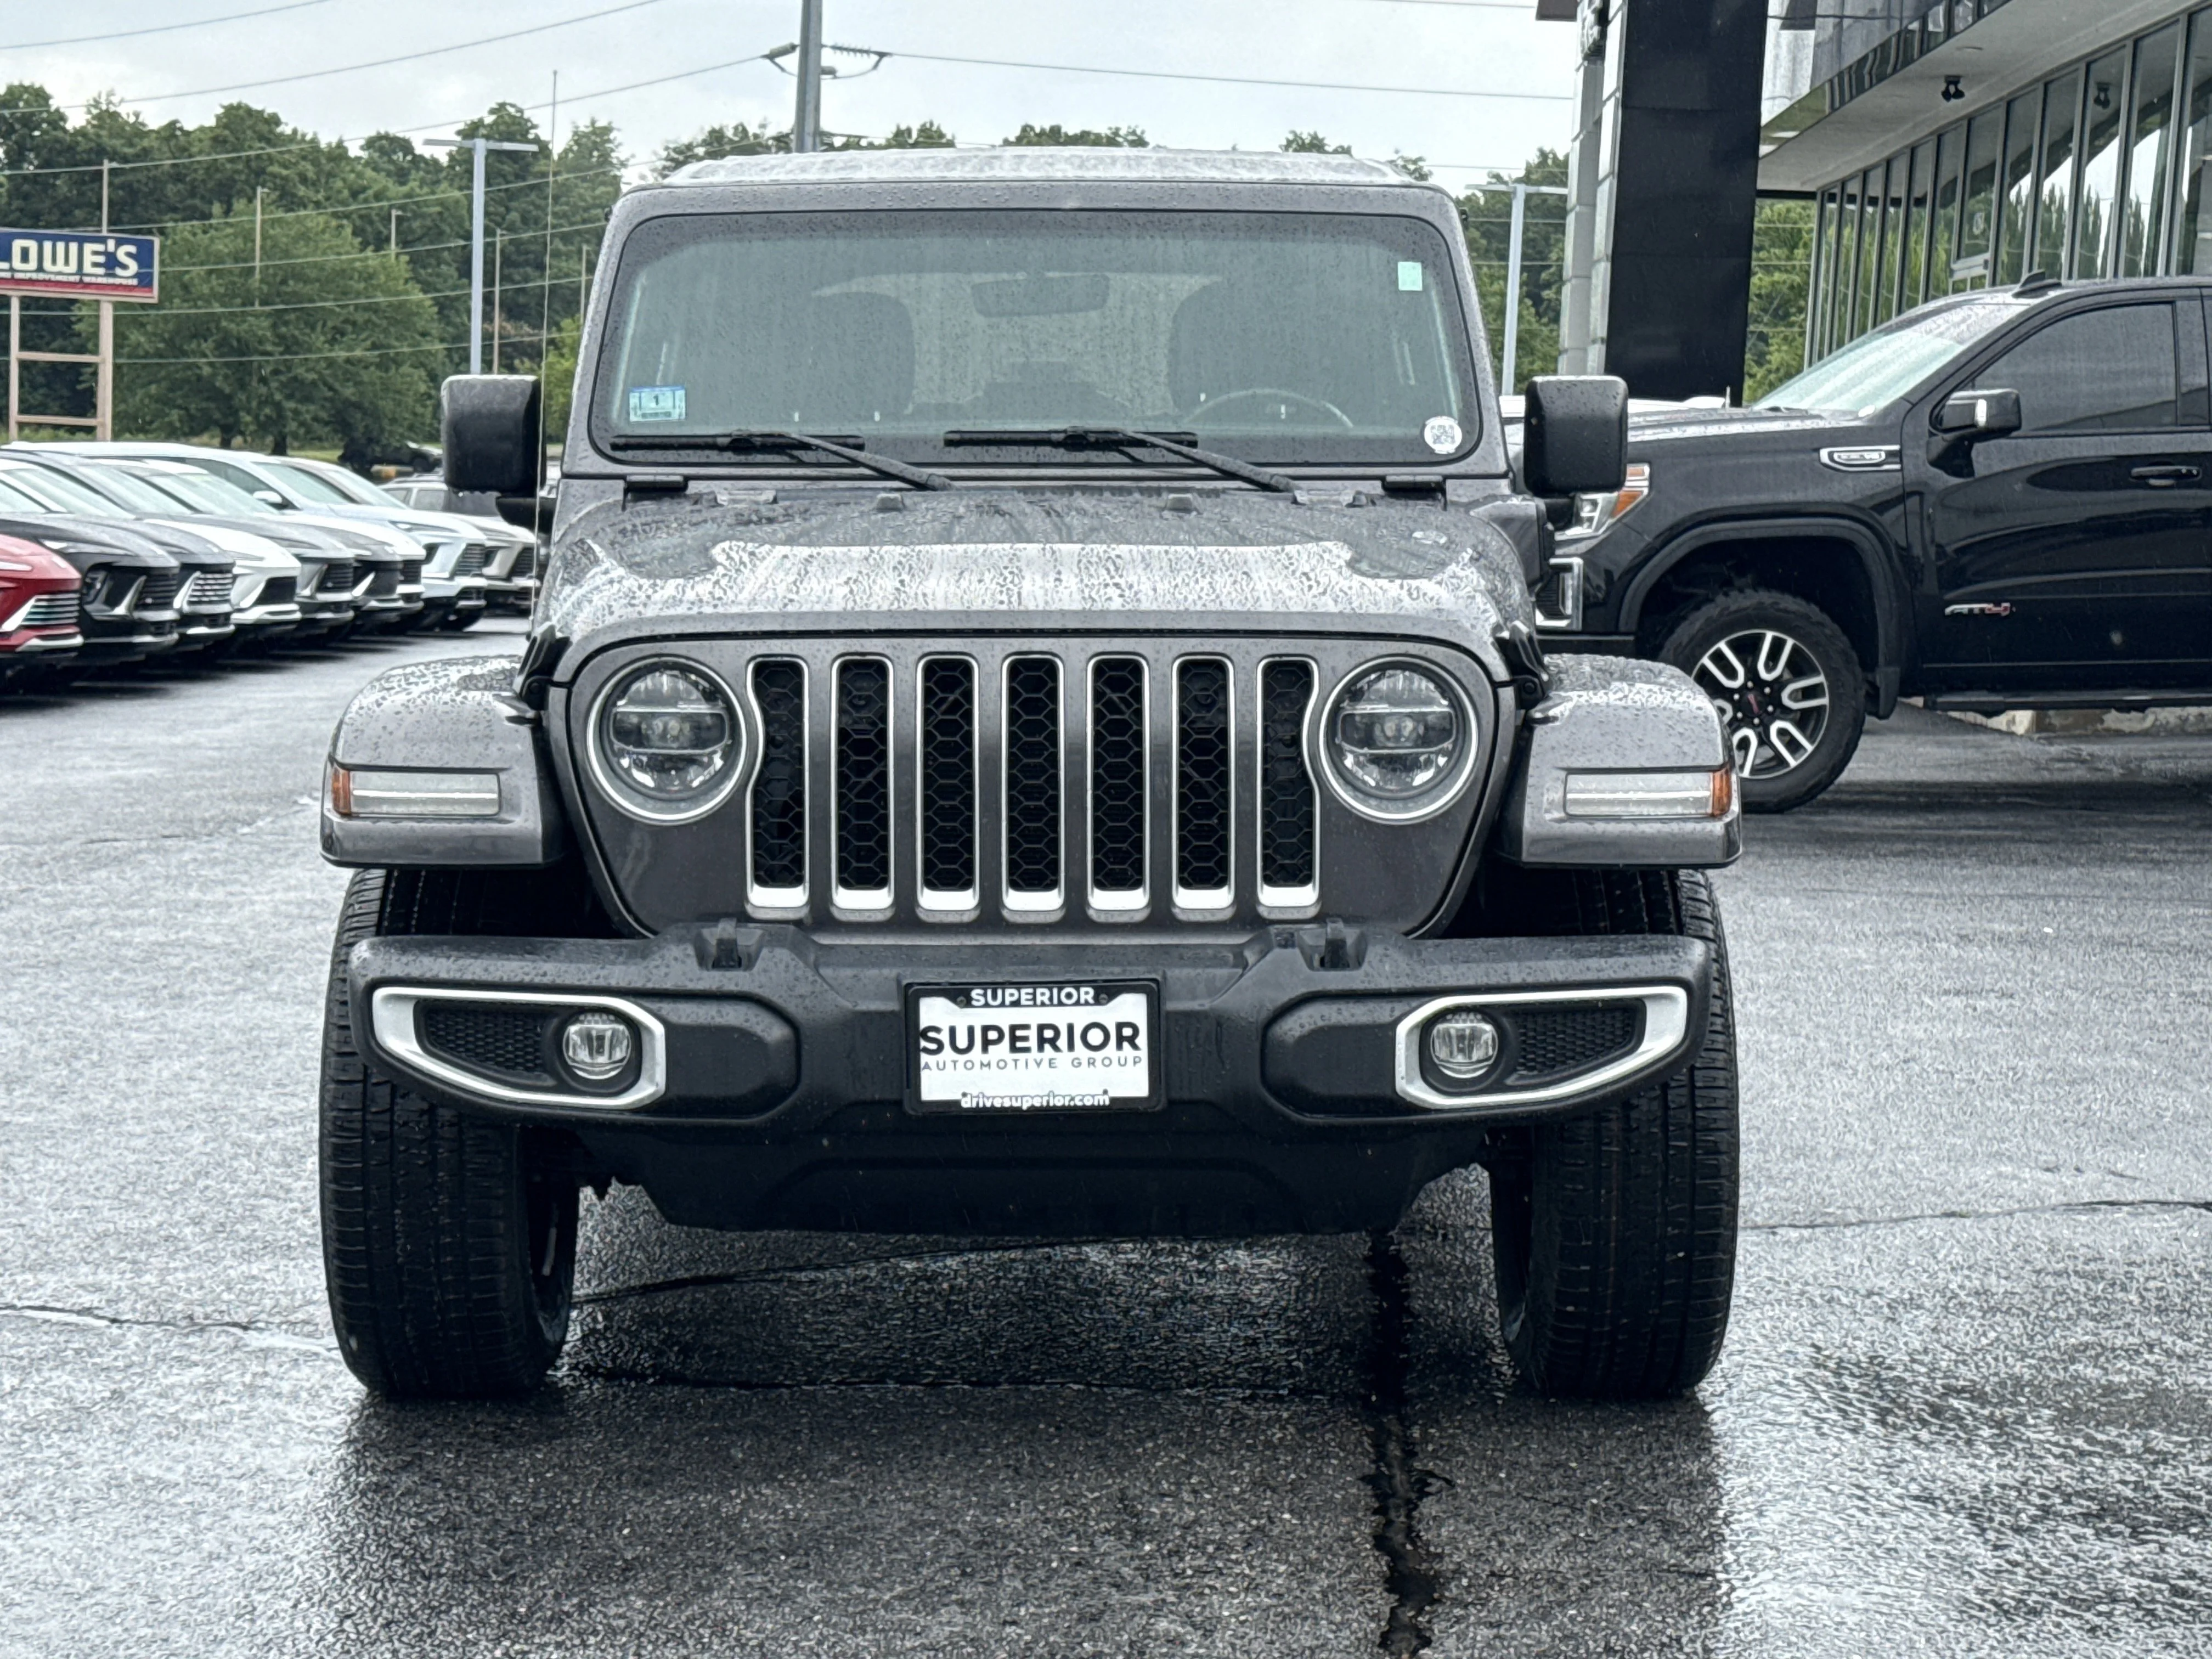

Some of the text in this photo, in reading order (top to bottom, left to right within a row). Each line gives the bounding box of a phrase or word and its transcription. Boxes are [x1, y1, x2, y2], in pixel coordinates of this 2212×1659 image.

[653, 394, 659, 406] 1
[969, 987, 1095, 1006] SUPERIOR
[920, 1021, 1142, 1056] SUPERIOR
[922, 1056, 1143, 1071] AUTOMOTIVE GROUP
[961, 1092, 1110, 1110] drivesuperior.com
